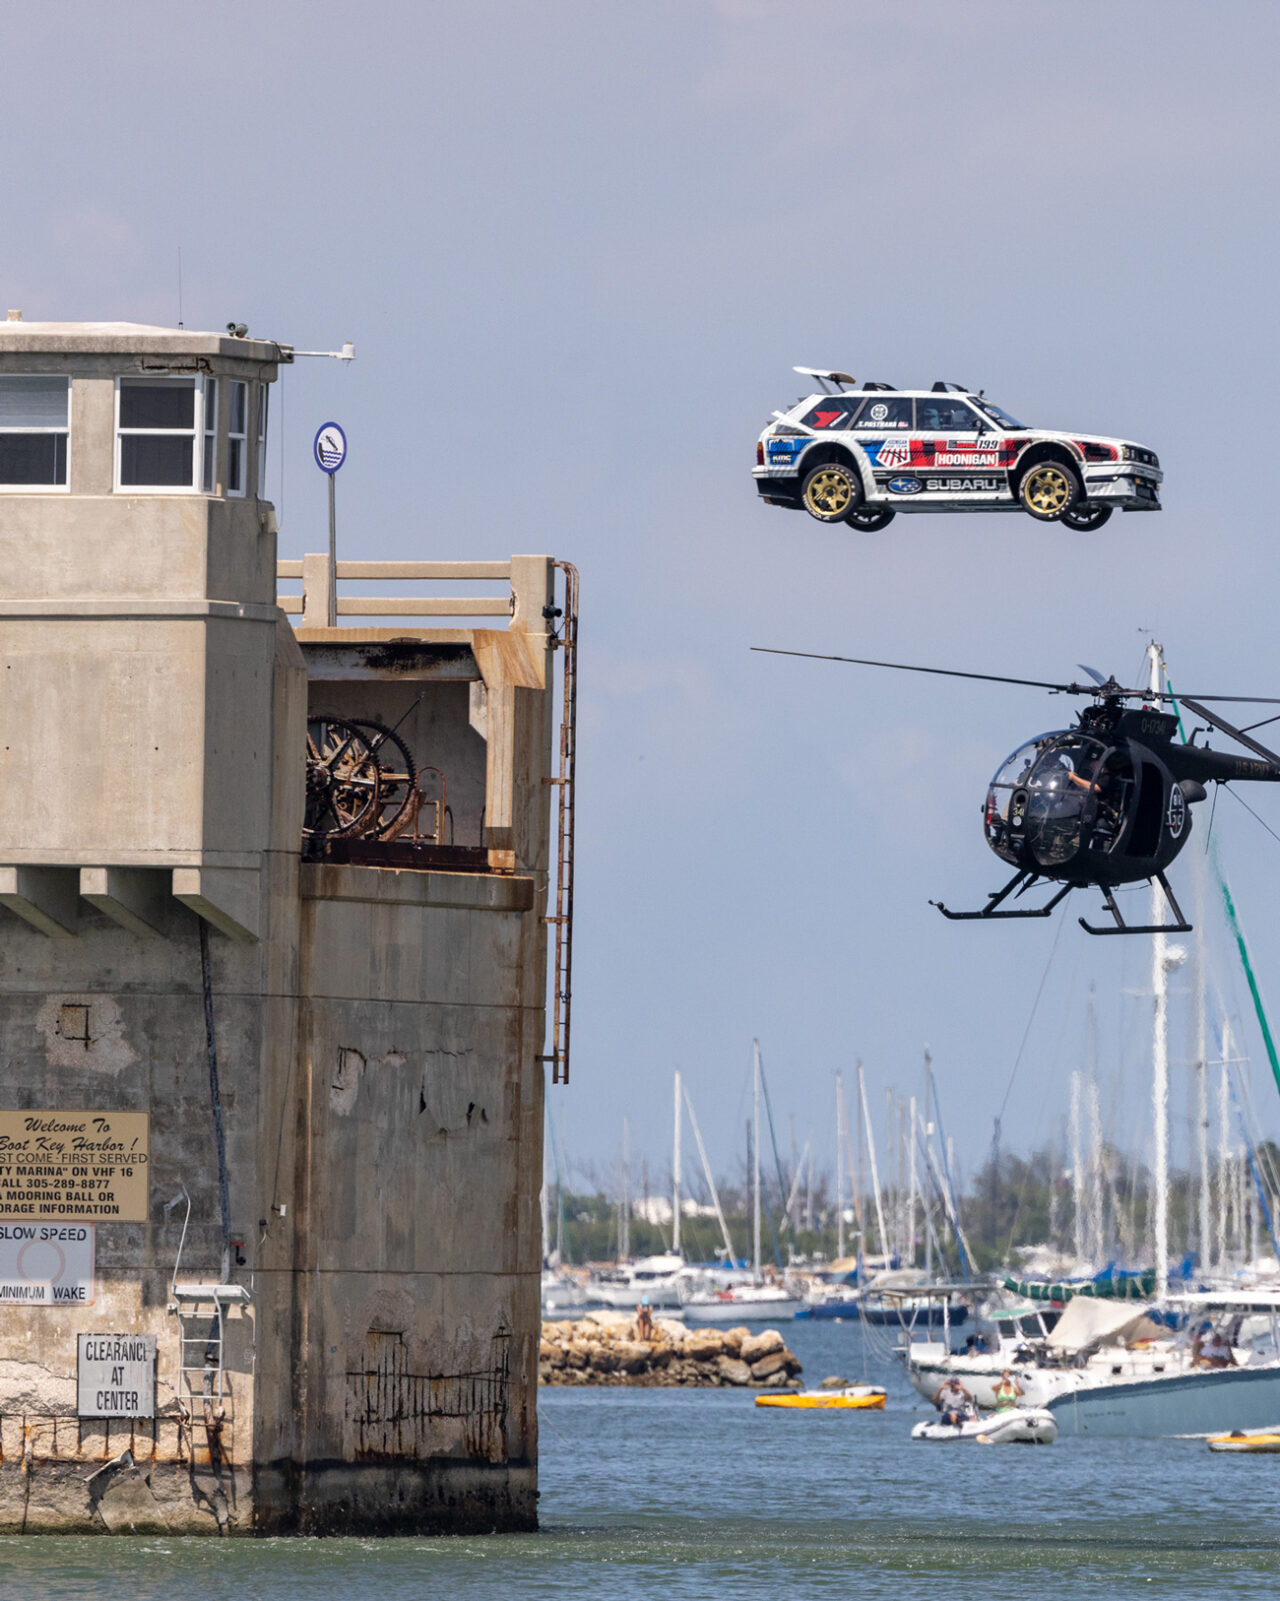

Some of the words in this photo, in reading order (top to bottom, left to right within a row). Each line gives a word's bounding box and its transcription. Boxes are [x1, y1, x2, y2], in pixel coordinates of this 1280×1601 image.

[978, 440, 999, 449] 199
[926, 479, 998, 491] SUBARU
[24, 1117, 87, 1133] Welcome
[92, 1118, 111, 1133] To
[0, 1135, 30, 1151] Boot
[35, 1136, 66, 1155] Key
[72, 1136, 125, 1151] Harbor
[16, 1153, 53, 1163] COME
[62, 1153, 95, 1163] FIRST
[99, 1153, 148, 1164] SERVED
[16, 1166, 68, 1176] MARINA"
[72, 1167, 88, 1176] ON
[93, 1167, 115, 1177] VHF
[120, 1167, 133, 1177] 16
[0, 1178, 22, 1188] ALL
[26, 1178, 110, 1189] 305-289-8877
[6, 1191, 62, 1201] MOORING
[66, 1191, 94, 1202] BALL
[98, 1192, 115, 1202] OR
[39, 1203, 120, 1215] INFORMATION
[0, 1226, 36, 1240] SLOW
[40, 1227, 87, 1241] SPEED
[0, 1285, 45, 1299] MINIMUM
[52, 1286, 86, 1300] WAKE
[111, 1366, 125, 1386] AT
[96, 1390, 138, 1411] CENTER
